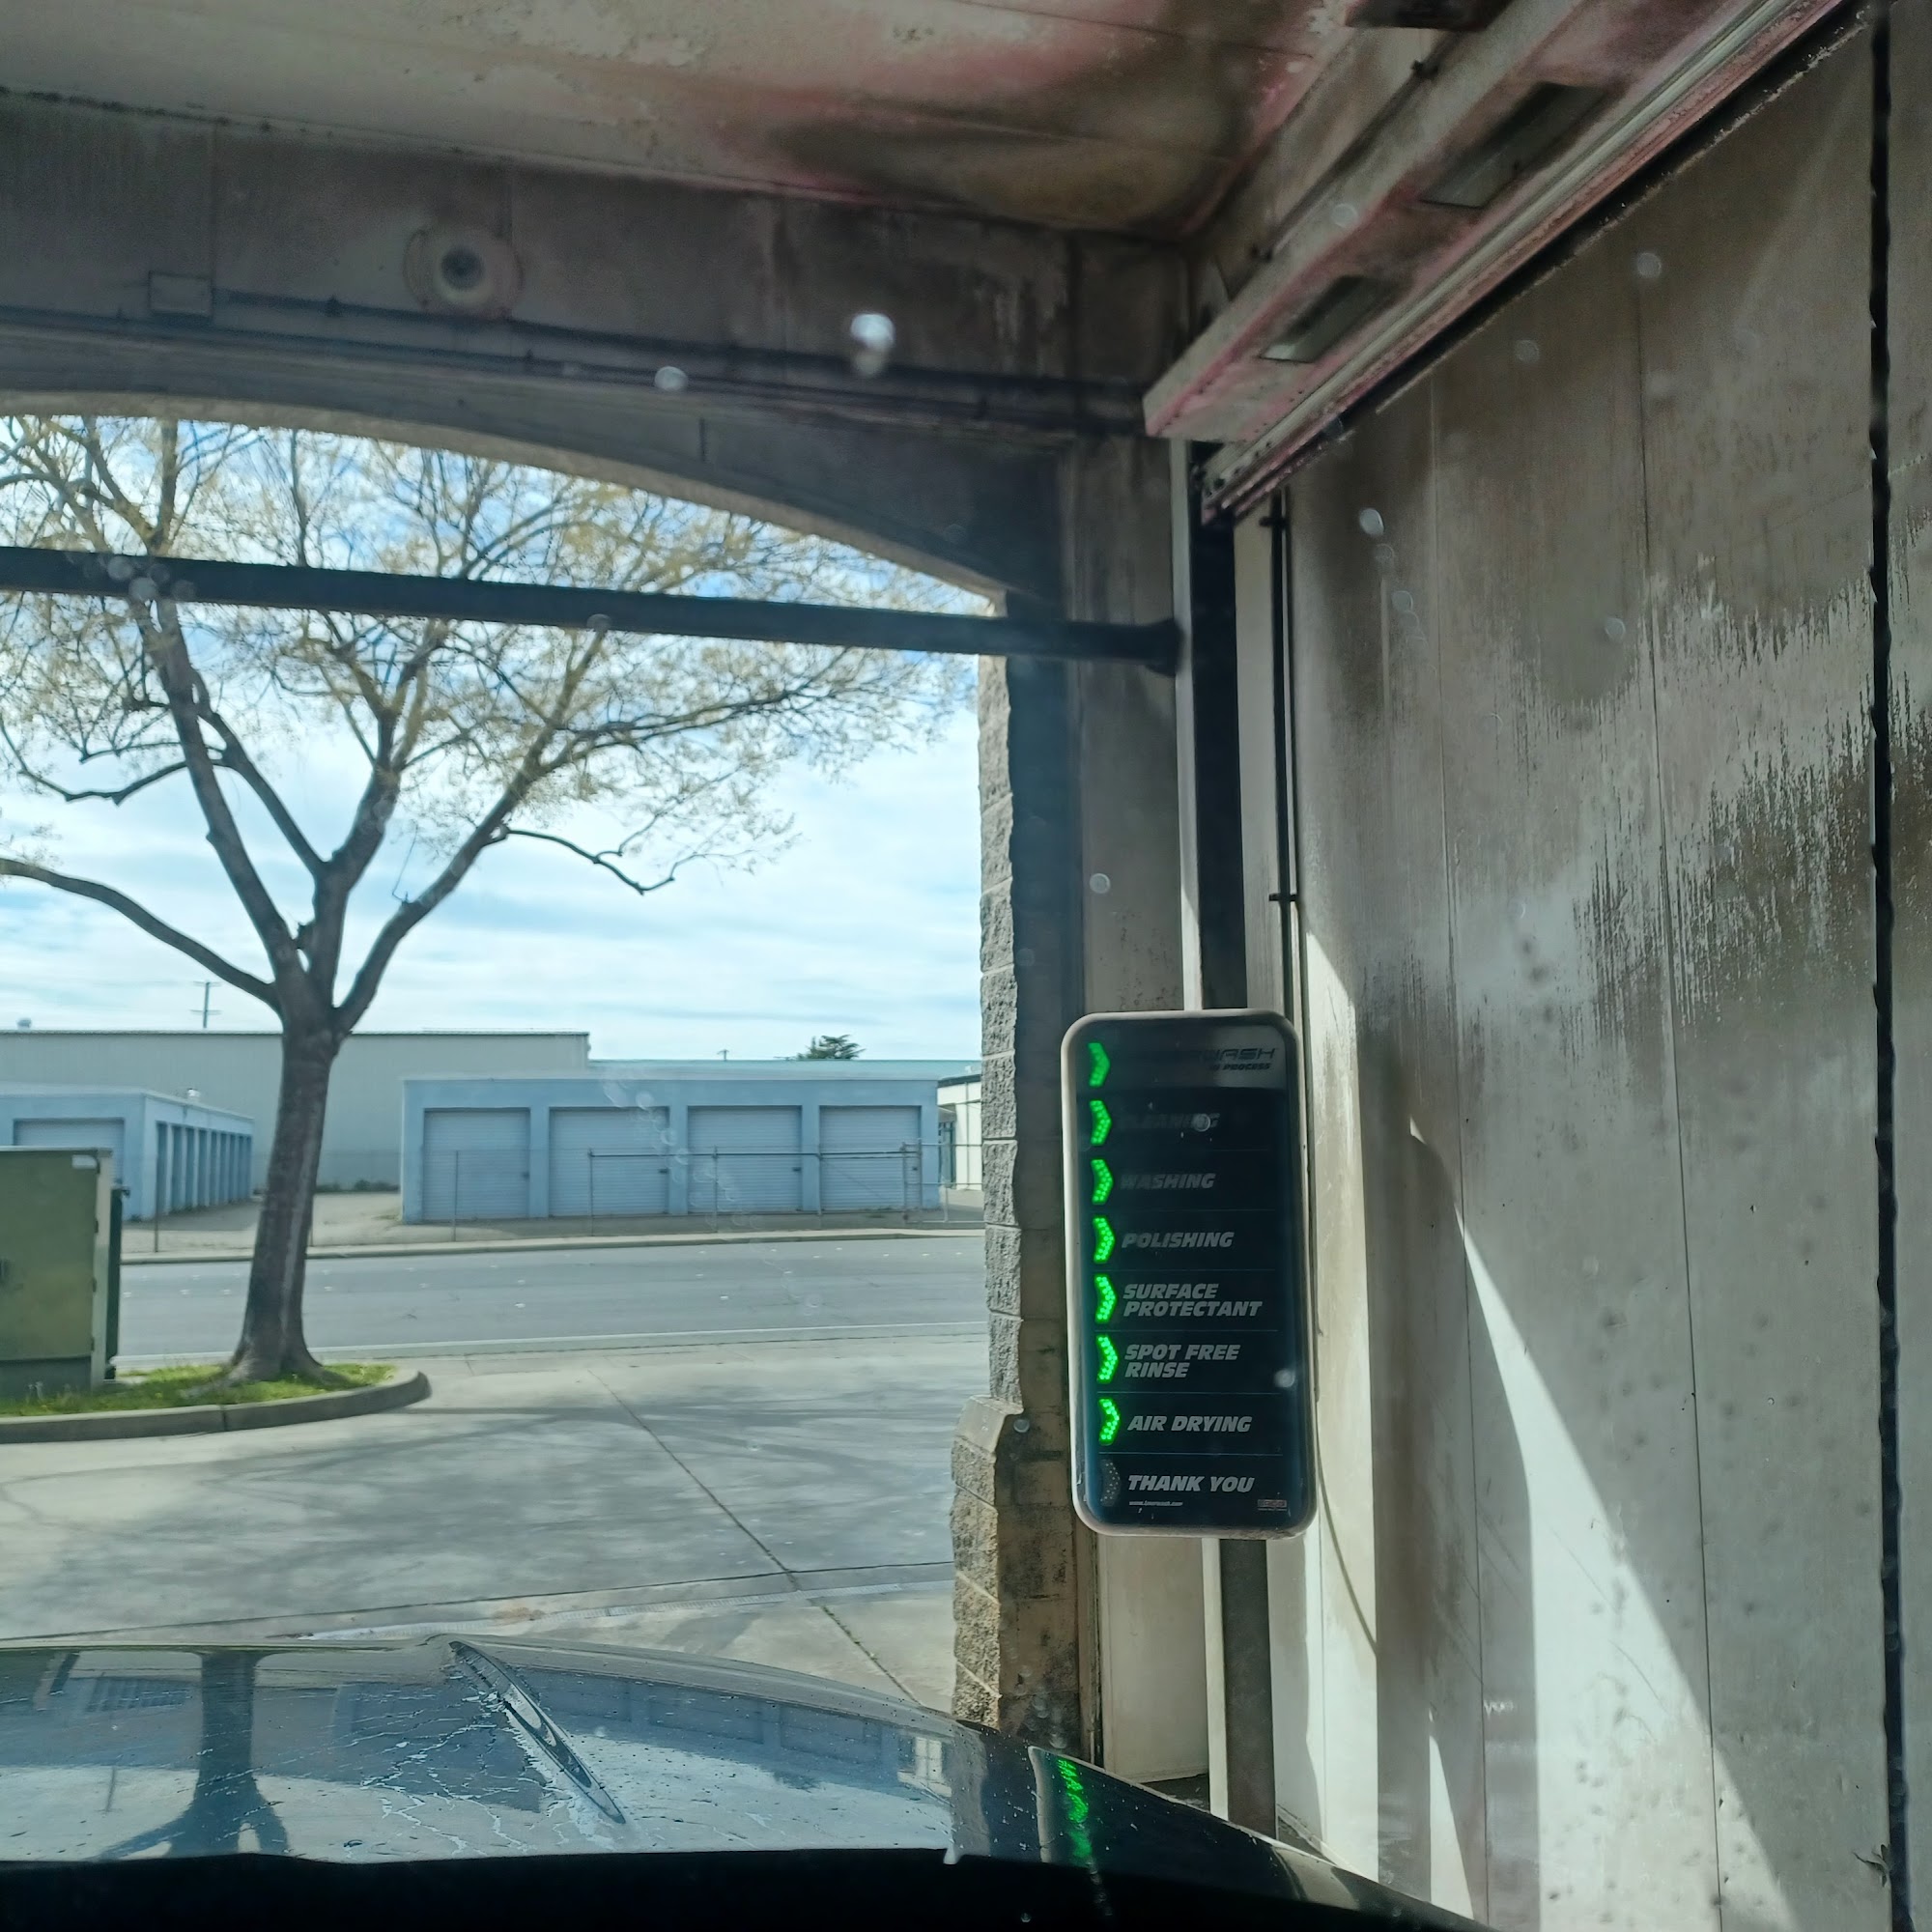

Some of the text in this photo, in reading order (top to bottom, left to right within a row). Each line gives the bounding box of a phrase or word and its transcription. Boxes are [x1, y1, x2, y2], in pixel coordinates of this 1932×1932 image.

[1120, 1173, 1216, 1190] WASHING
[1121, 1232, 1235, 1249] POLISHING
[1122, 1283, 1219, 1299] SURFACE
[1122, 1301, 1263, 1318] PROTECTANT
[1124, 1344, 1241, 1361] SPOT FREE
[1124, 1362, 1190, 1378] RINSE
[1126, 1416, 1253, 1433] AIR DRYING
[1127, 1474, 1255, 1493] THANK YOU
